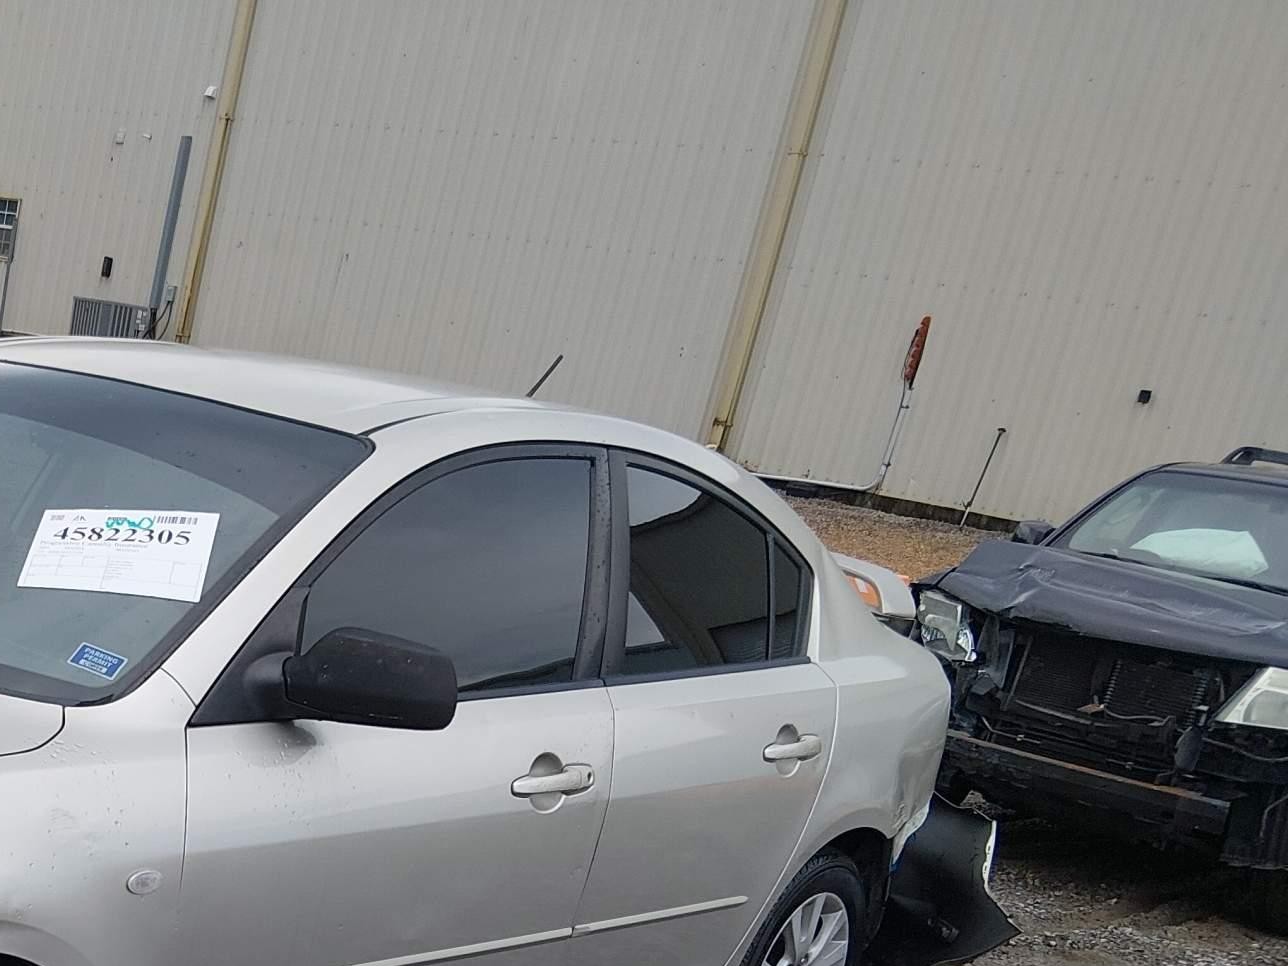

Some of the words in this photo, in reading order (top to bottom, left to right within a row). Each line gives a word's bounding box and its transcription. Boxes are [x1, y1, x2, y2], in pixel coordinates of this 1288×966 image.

[53, 527, 192, 546] 45822305
[82, 654, 113, 668] PERMIT
[84, 647, 119, 664] PARKING
